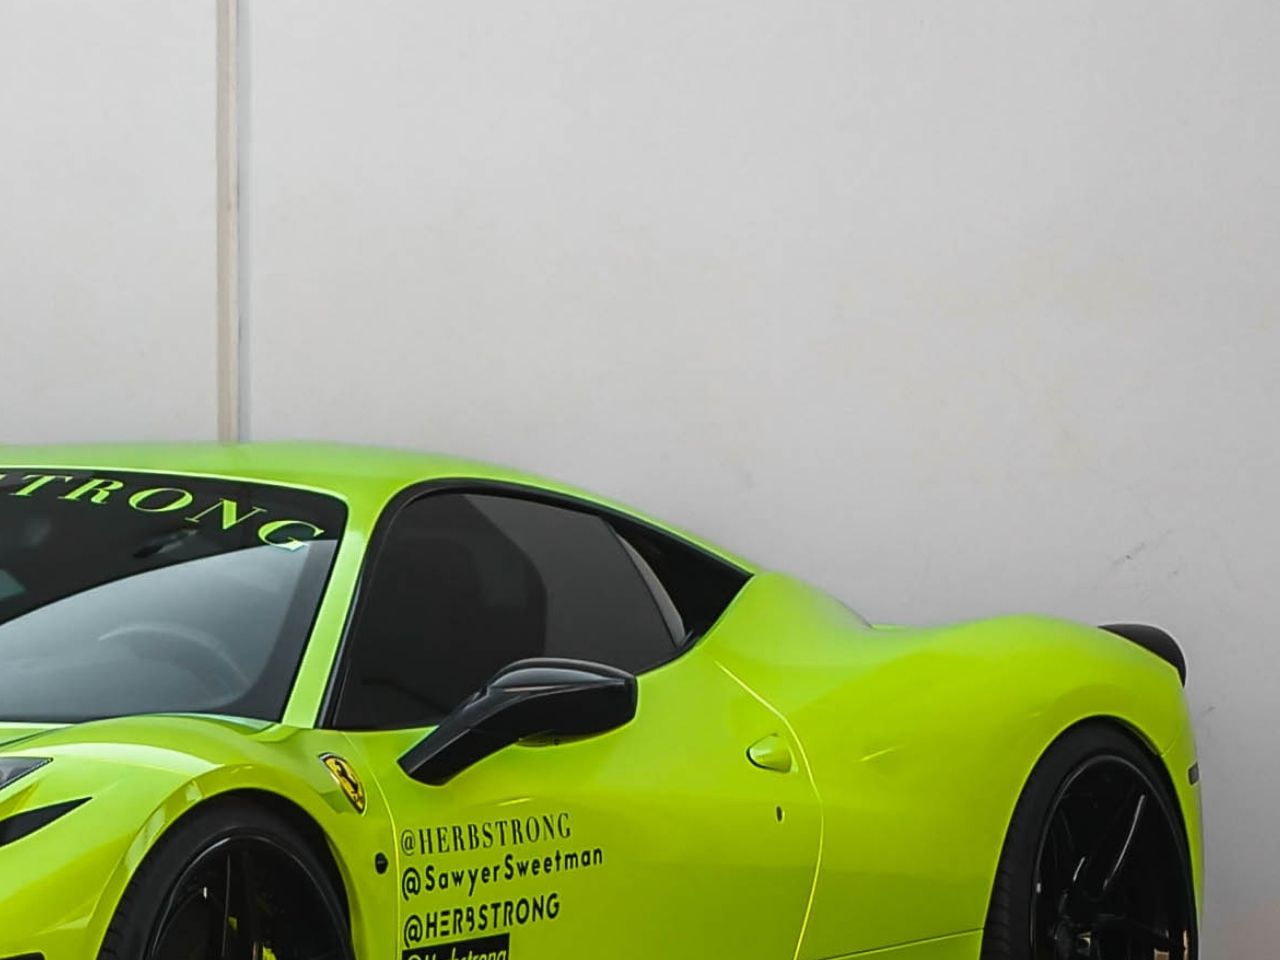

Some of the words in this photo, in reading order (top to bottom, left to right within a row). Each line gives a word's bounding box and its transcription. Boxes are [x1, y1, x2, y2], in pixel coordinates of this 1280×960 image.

[401, 813, 571, 856] @HERBSTRONG
[402, 848, 602, 901] @SawyerSweetman
[403, 893, 560, 948] @HERBSTRONG
